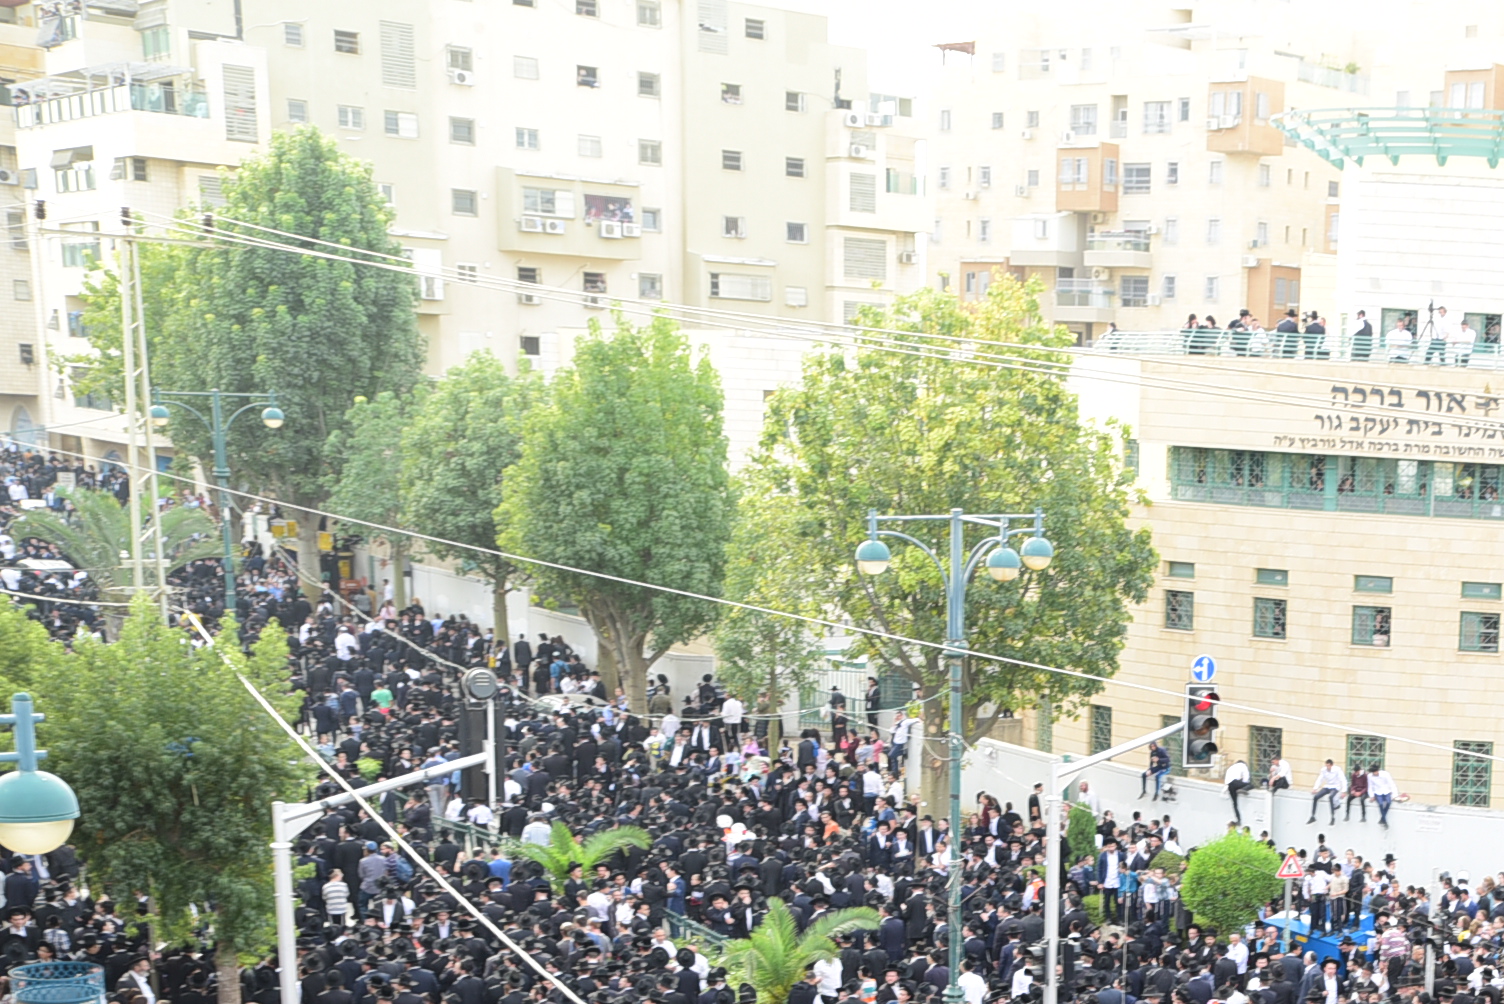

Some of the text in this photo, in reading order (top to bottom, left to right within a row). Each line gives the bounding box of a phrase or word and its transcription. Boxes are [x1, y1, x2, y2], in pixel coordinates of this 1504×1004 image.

[1330, 384, 1467, 413] אור ברכה
[1314, 414, 1342, 431] גור
[1348, 416, 1399, 438] יעקב
[1406, 418, 1443, 437] בית
[1340, 437, 1364, 450] אדל
[1367, 440, 1399, 452] ברכה
[1403, 442, 1430, 454] מרת
[1433, 444, 1485, 457] החשובה
